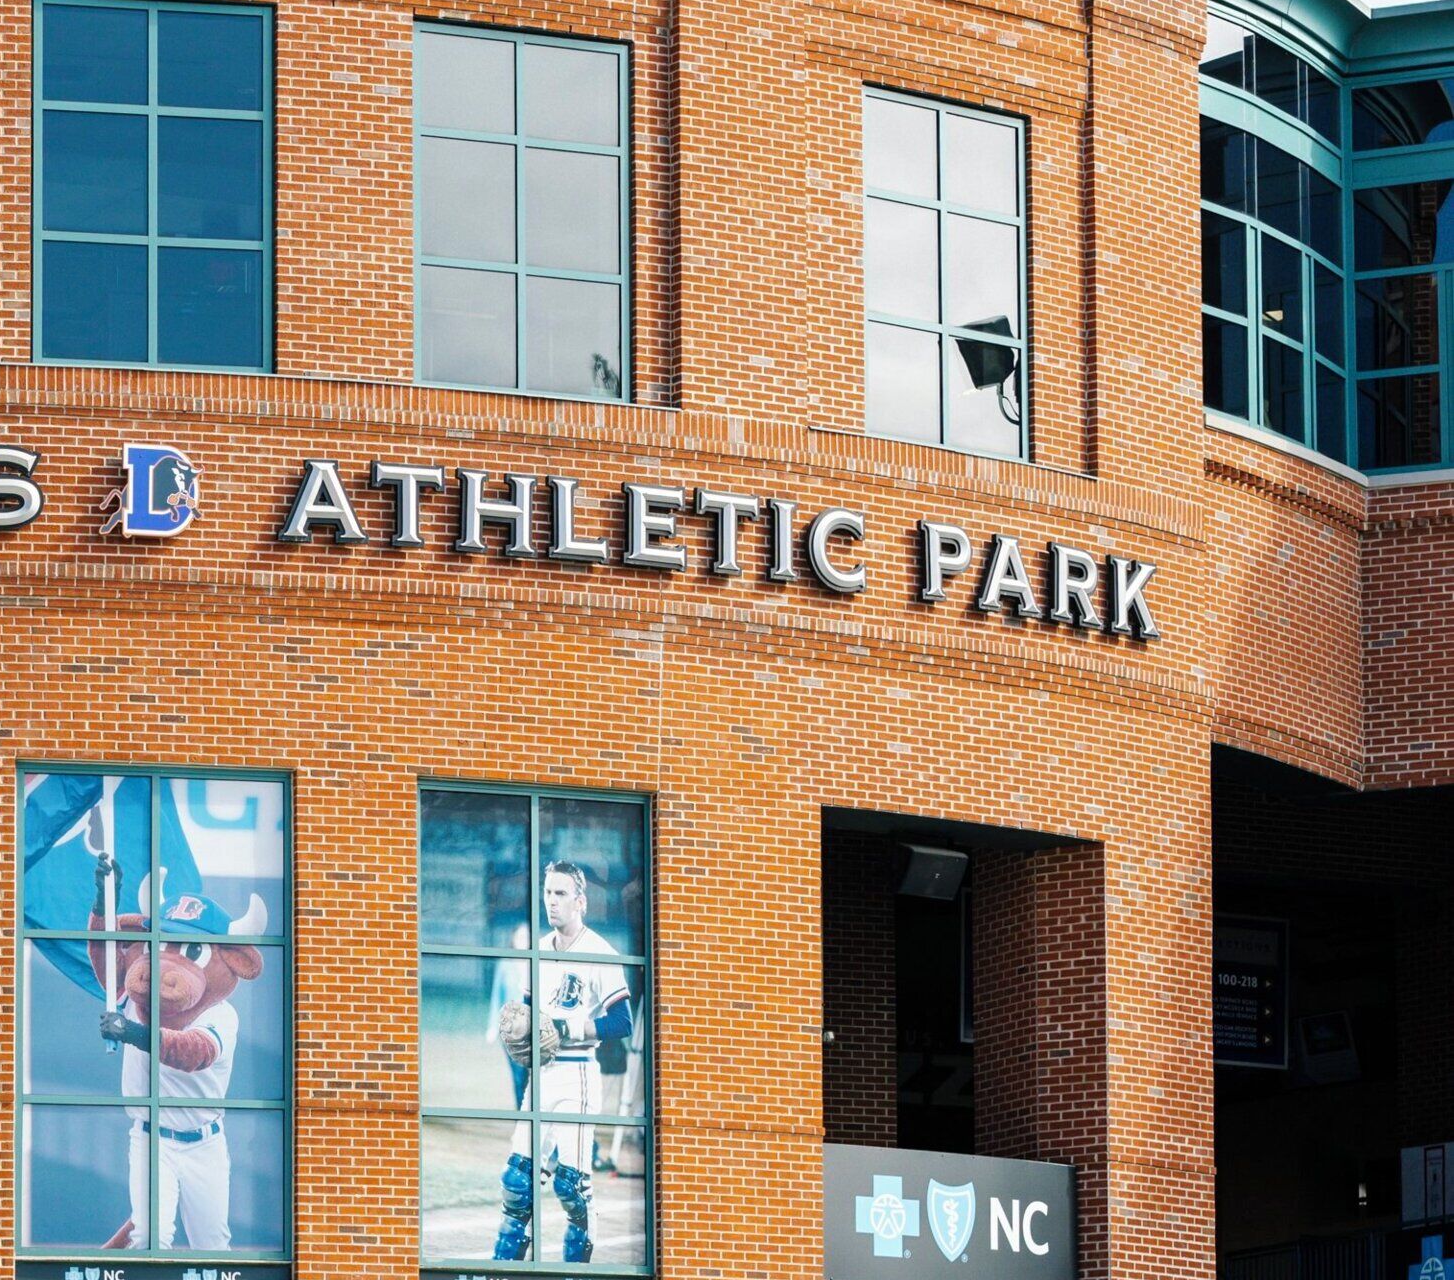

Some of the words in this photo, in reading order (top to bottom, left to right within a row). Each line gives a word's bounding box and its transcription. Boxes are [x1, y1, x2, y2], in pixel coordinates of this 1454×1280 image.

[277, 459, 867, 593] ATHLETIC
[919, 519, 1160, 639] PARK
[1218, 973, 1258, 988] 100-218
[989, 1197, 1050, 1256] NC
